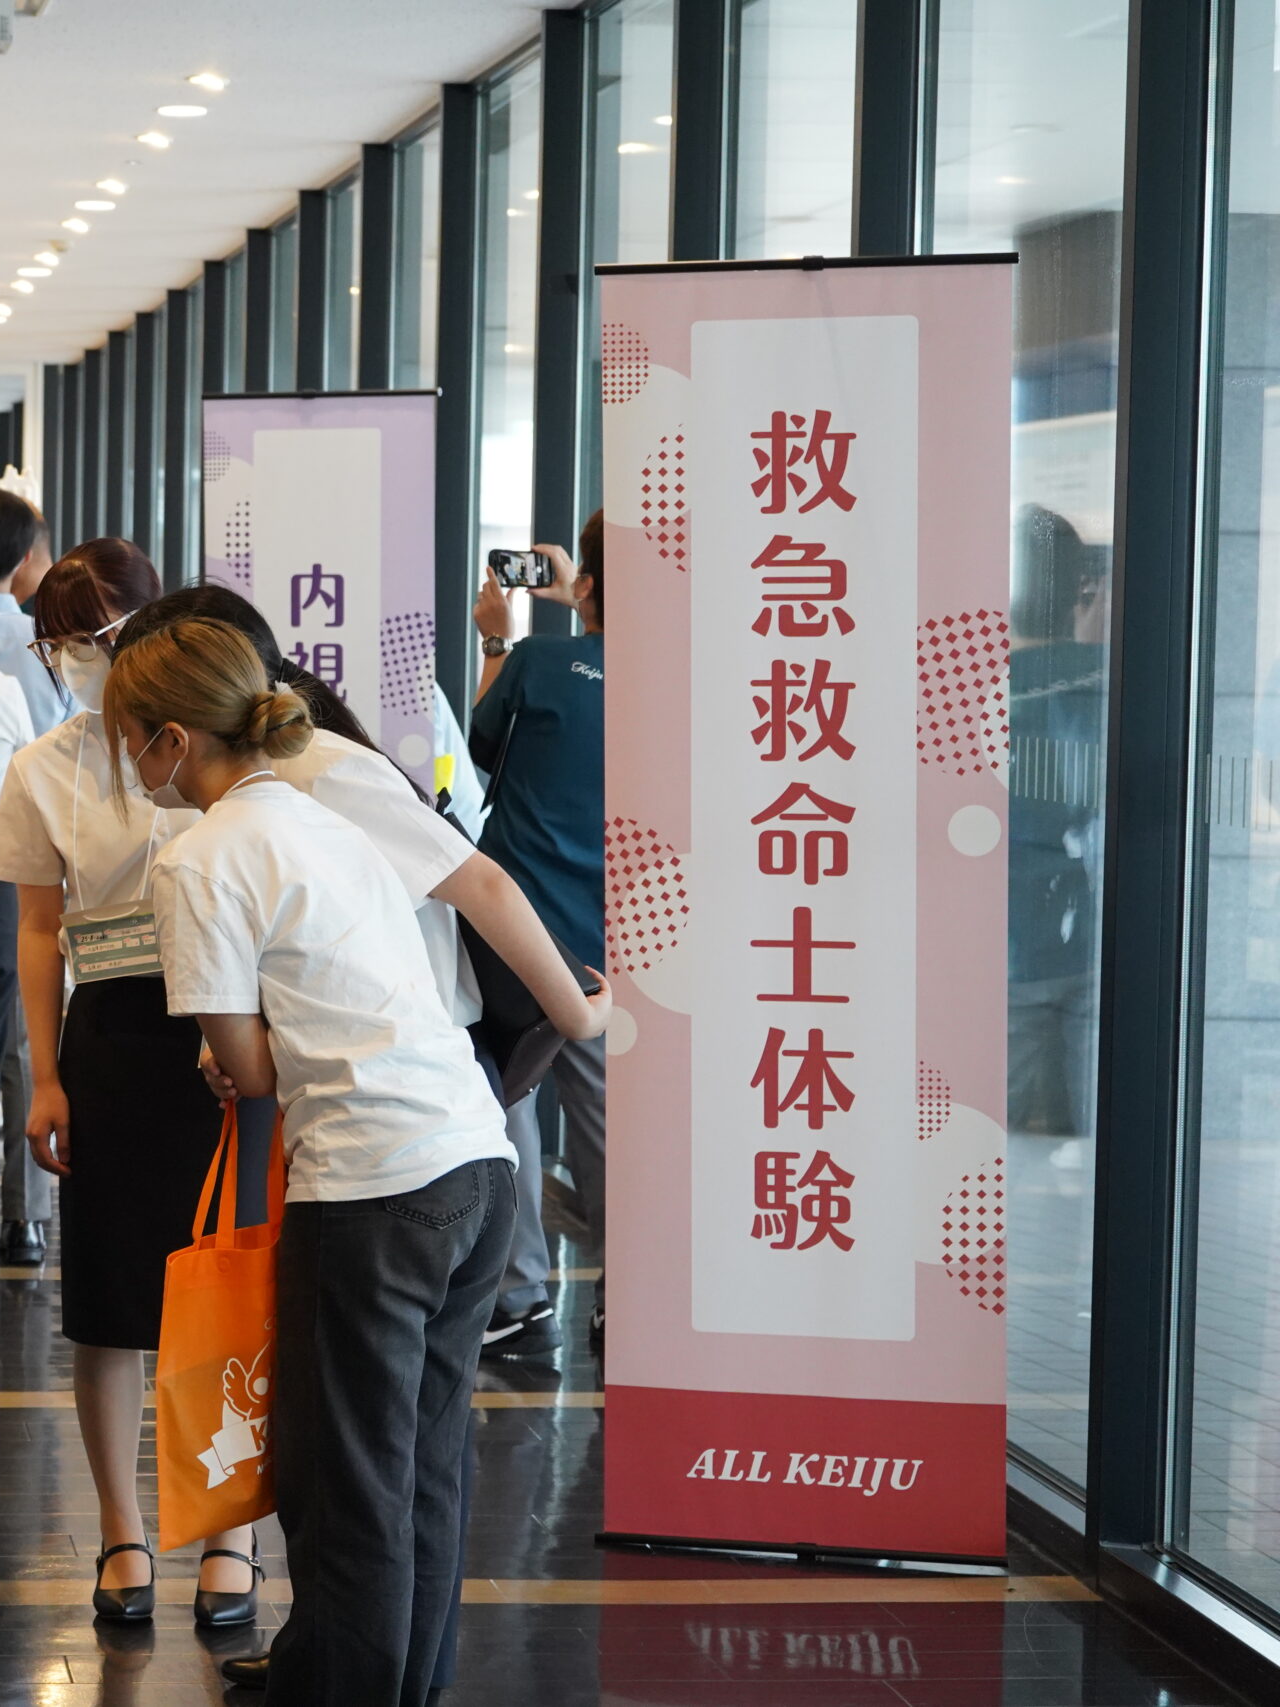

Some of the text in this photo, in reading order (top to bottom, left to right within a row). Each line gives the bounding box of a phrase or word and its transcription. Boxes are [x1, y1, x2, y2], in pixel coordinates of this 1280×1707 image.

[750, 409, 857, 1252] 救急救命士体験
[686, 1448, 924, 1497] ALL KEIJU
